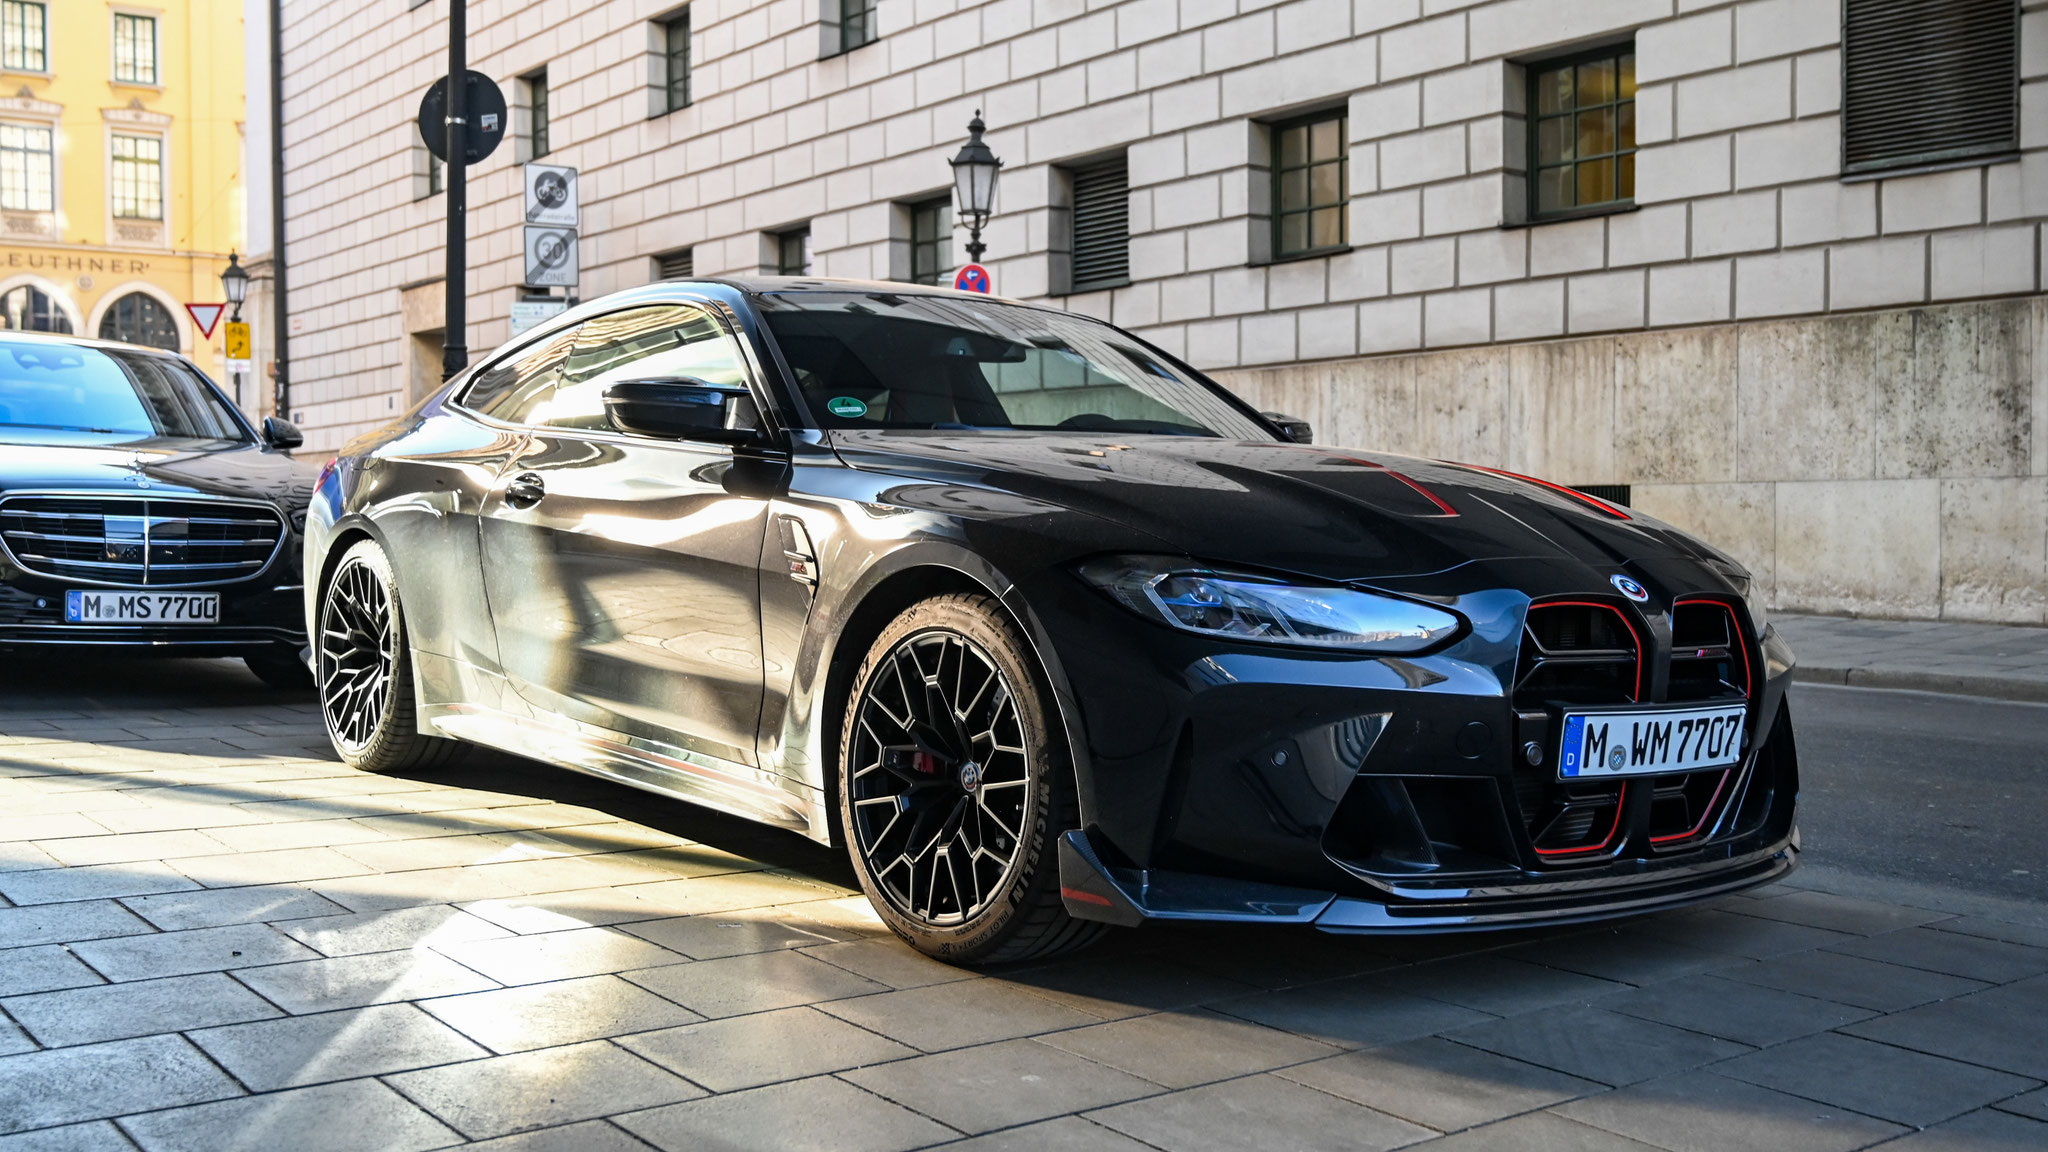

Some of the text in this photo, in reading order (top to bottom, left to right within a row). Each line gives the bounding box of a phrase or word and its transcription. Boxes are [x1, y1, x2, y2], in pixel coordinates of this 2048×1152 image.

[542, 241, 563, 260] 30
[539, 272, 567, 283] ZONE
[84, 595, 217, 619] M MS 7700
[1583, 714, 1741, 769] M WM 7707
[1566, 752, 1575, 766] D
[1012, 782, 1050, 903] MICHELIN
